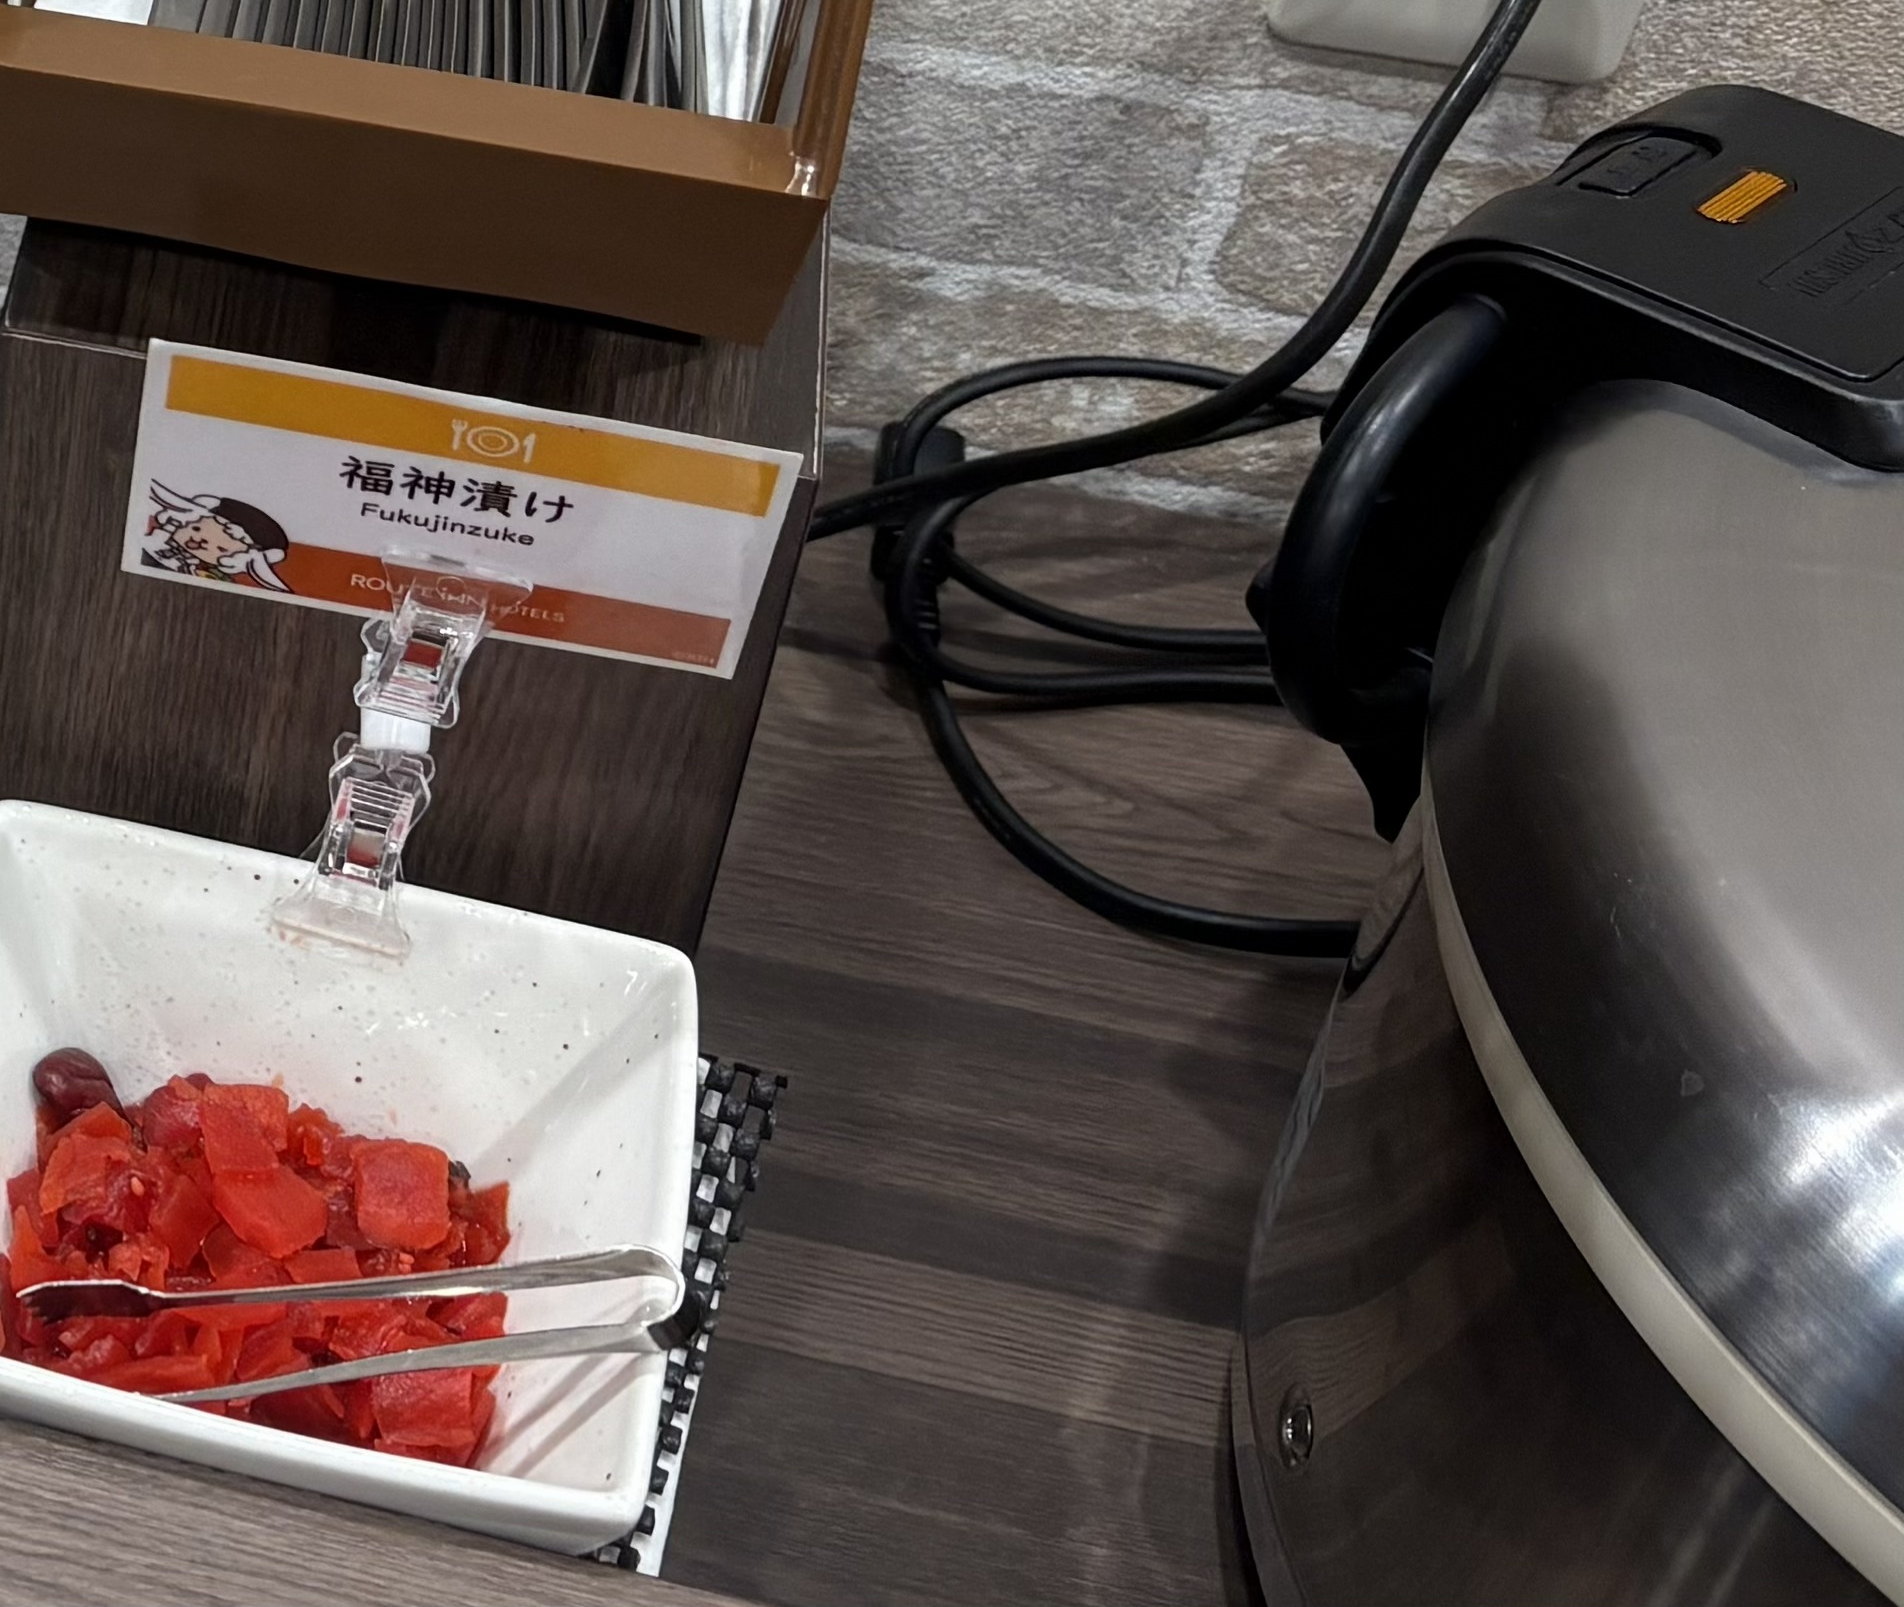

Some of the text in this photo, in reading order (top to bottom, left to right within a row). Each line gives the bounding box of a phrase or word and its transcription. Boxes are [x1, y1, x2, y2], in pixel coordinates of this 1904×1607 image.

[339, 456, 574, 525] 福神漬け
[361, 502, 534, 547] Fukujinzuke
